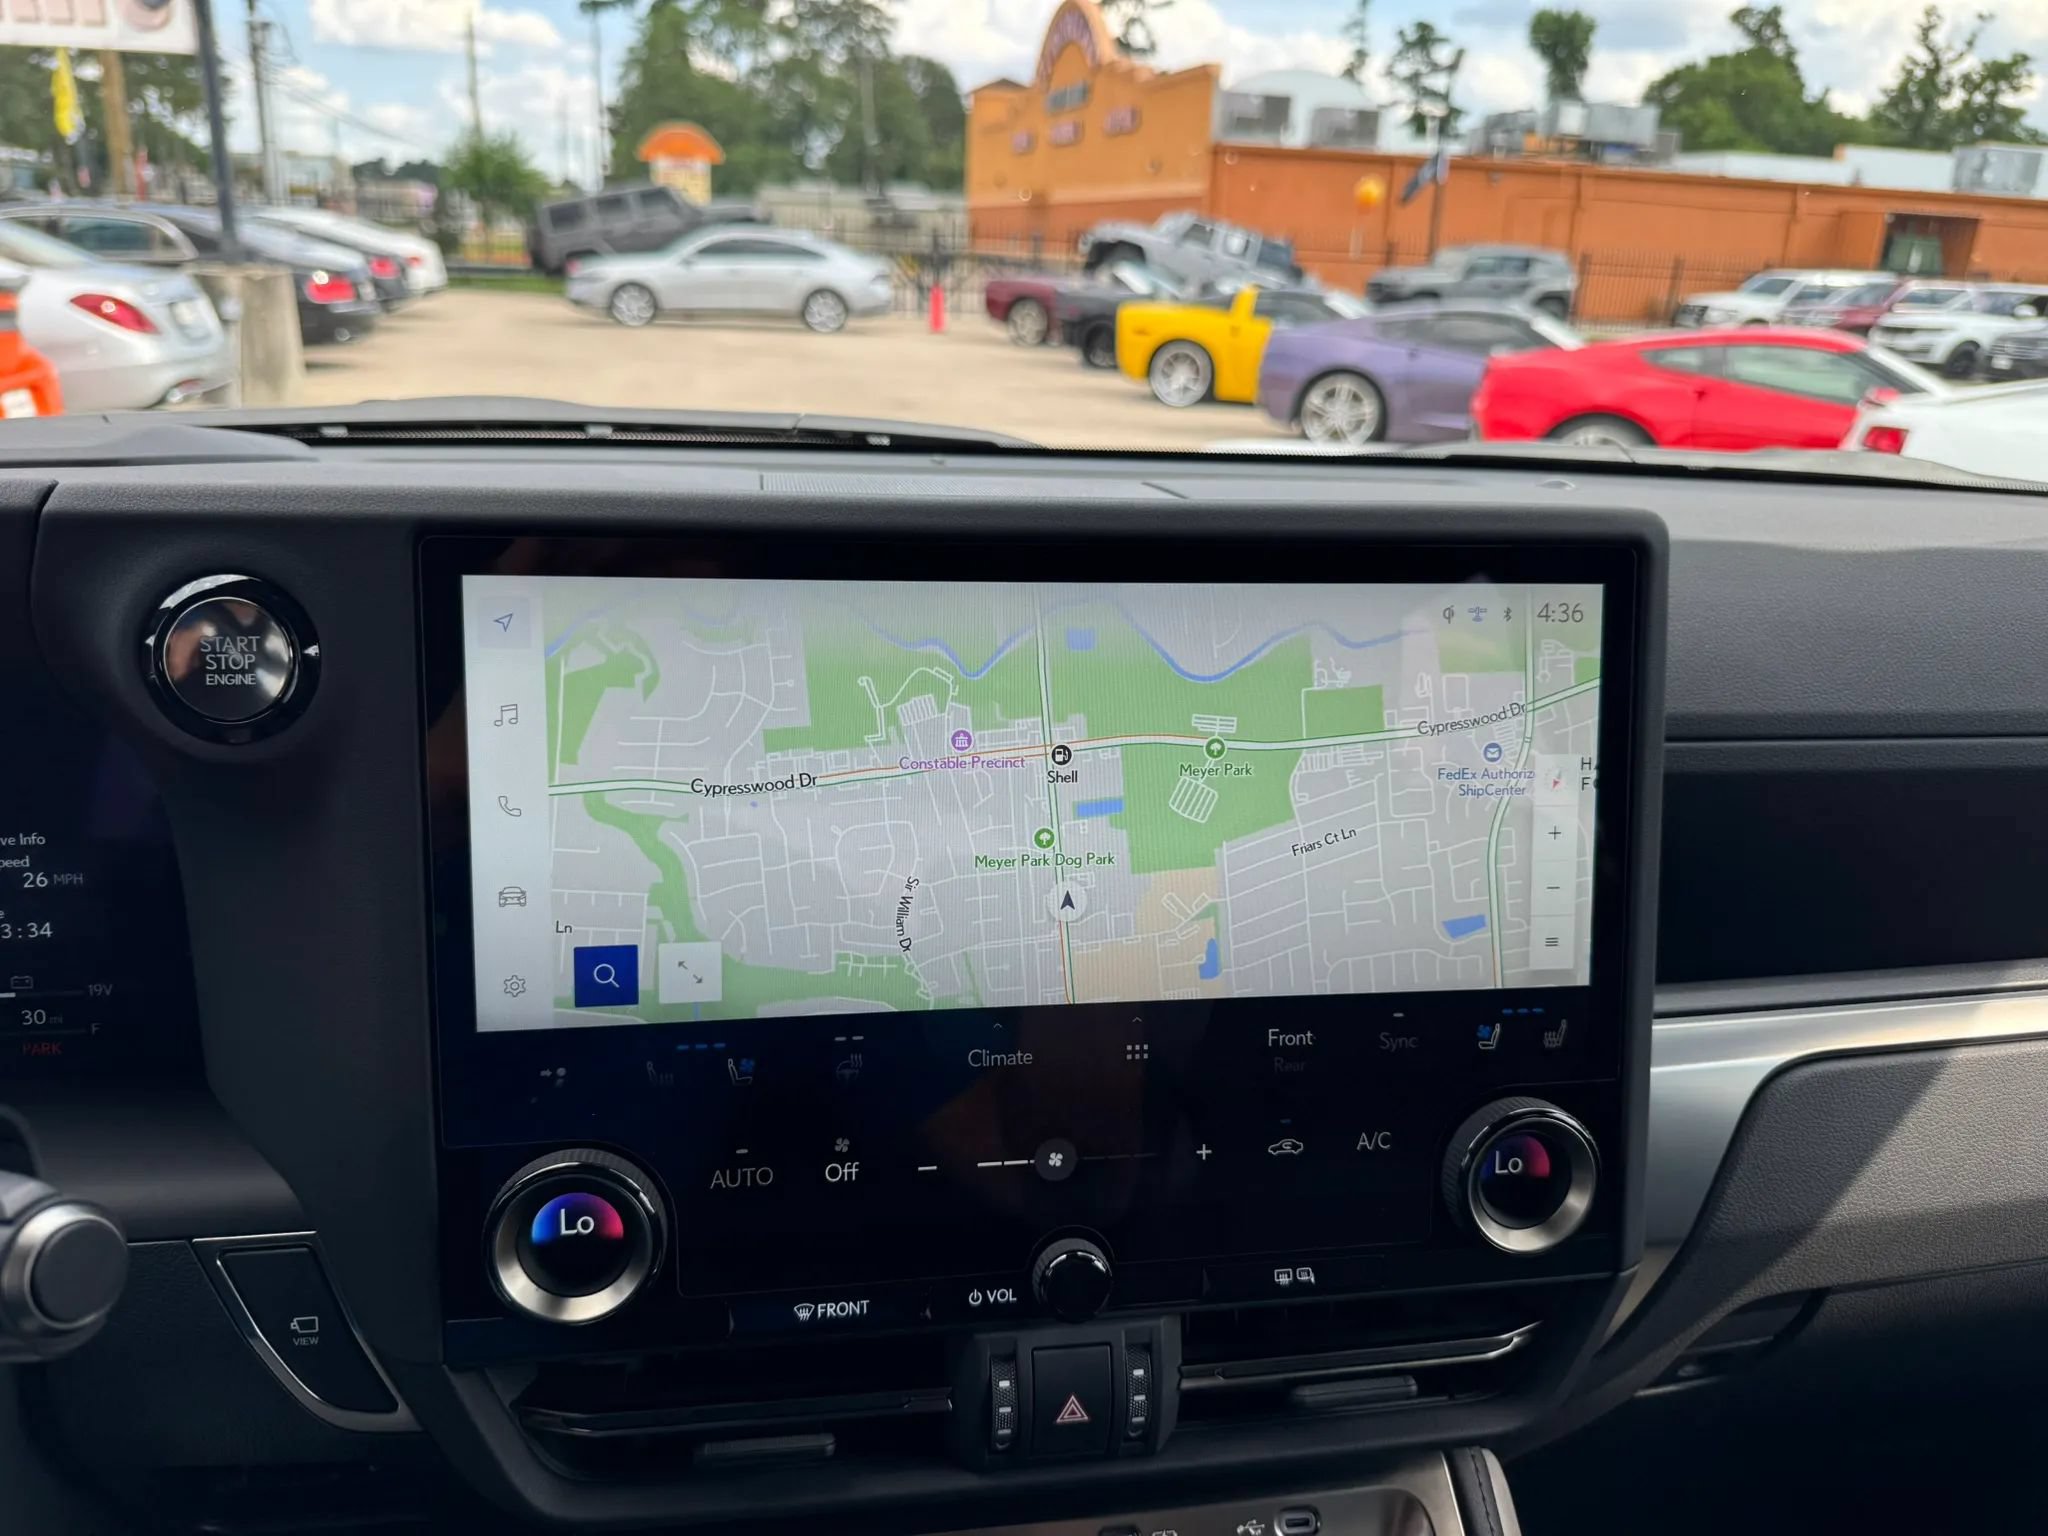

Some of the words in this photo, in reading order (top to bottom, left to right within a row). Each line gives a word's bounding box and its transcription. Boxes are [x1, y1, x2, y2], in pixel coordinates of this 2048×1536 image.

[1536, 602, 1584, 623] 4:36
[200, 635, 261, 652] START
[205, 653, 256, 670] STOP
[205, 673, 257, 686] ENGINE
[1418, 705, 1507, 736] Cypresswood
[1509, 702, 1526, 717] Dr
[899, 755, 968, 770] Constable
[971, 754, 1026, 769] Precinct
[1179, 763, 1221, 778] Meyer
[1224, 763, 1253, 776] Park
[1047, 770, 1079, 784] Shell
[1437, 767, 1477, 780] FedEx
[1480, 767, 1535, 780] Authoriz
[690, 774, 795, 797] Cypresswood
[799, 772, 818, 789] Dr
[1458, 783, 1527, 799] ShipCenter
[19, 832, 46, 846] Info
[1291, 840, 1323, 857] Friars
[1323, 832, 1340, 846] Ct
[1341, 827, 1357, 840] Ln
[974, 854, 1016, 870] Meyer
[1020, 853, 1051, 867] Park
[1054, 853, 1082, 869] Dog
[1086, 852, 1116, 866] Park
[23, 872, 48, 888] 26
[53, 872, 84, 886] MPH
[904, 875, 920, 893] Sir
[895, 895, 914, 937] William
[555, 919, 573, 934] Ln
[899, 937, 912, 953] Dr
[88, 983, 113, 997] 19V
[21, 1009, 47, 1026] 30
[91, 1022, 101, 1036] F
[1267, 1028, 1313, 1047] Front
[22, 1042, 63, 1056] PARK
[1379, 1031, 1418, 1052] Sync
[967, 1048, 1034, 1069] Climate
[1273, 1056, 1306, 1073] Rear
[1356, 1131, 1392, 1151] A/C
[1495, 1150, 1523, 1174] Lo
[710, 1166, 774, 1190] AUTO
[824, 1162, 860, 1184] Off
[559, 1208, 595, 1237] Lo
[987, 1288, 1018, 1304] VOL
[817, 1300, 870, 1320] FRONT
[292, 1336, 320, 1346] VIEW
